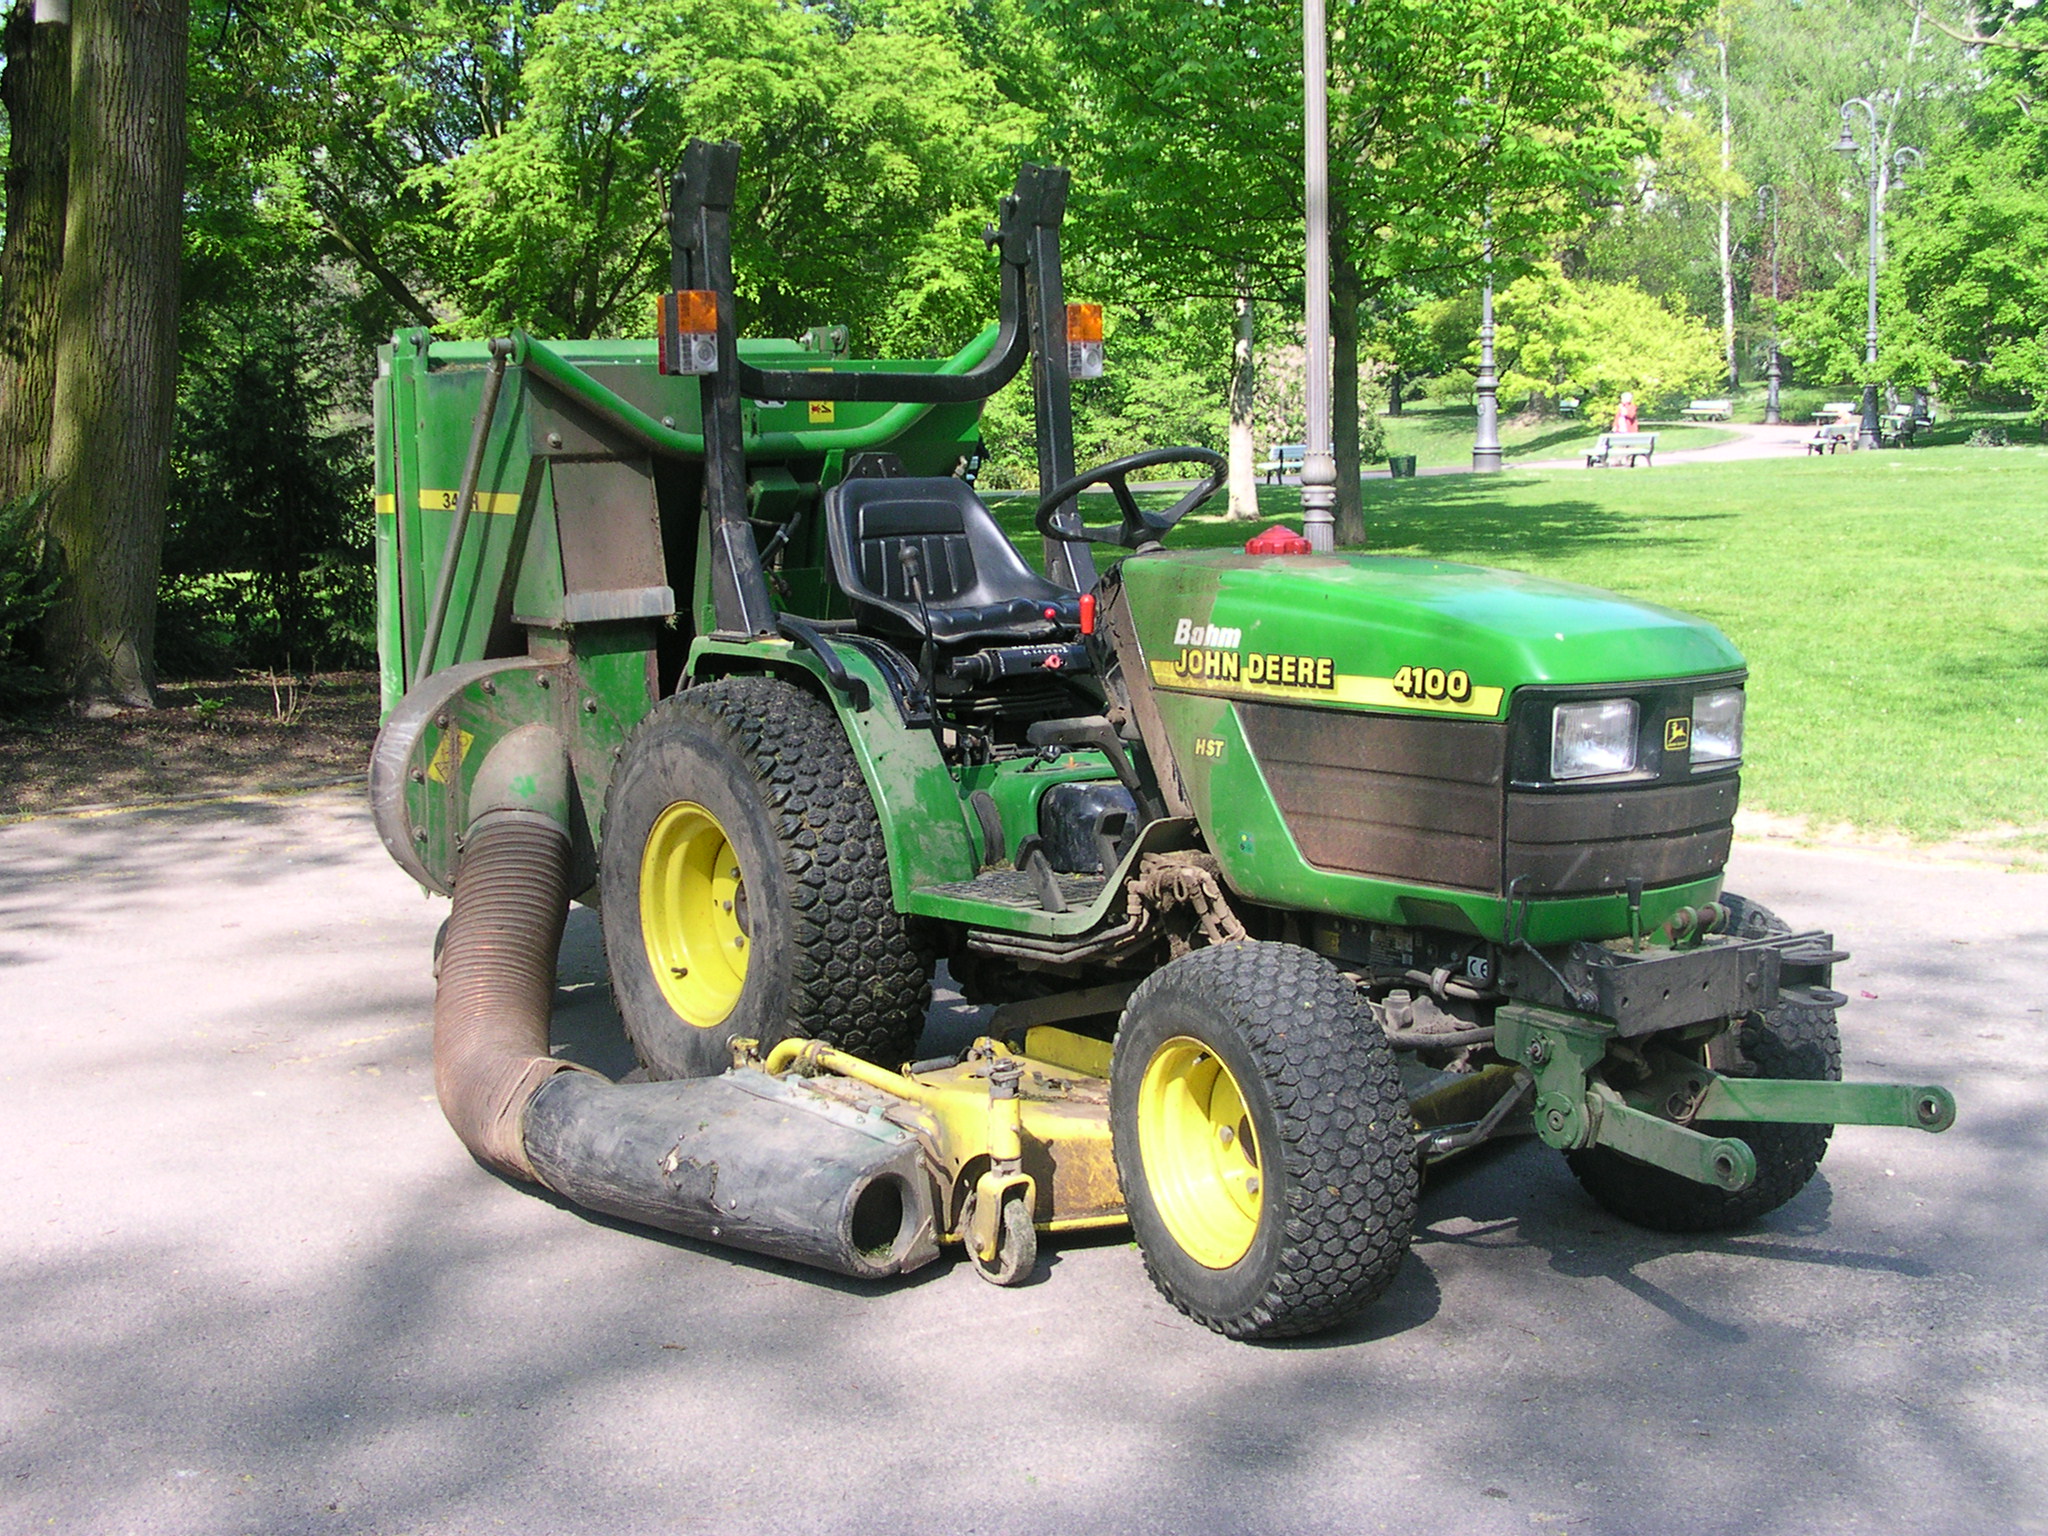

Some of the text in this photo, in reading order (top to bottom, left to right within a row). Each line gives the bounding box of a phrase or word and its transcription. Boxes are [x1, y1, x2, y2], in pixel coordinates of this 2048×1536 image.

[1174, 648, 1335, 690] JOHN DEERE
[1393, 665, 1472, 703] 4100
[1194, 737, 1225, 758] HST
